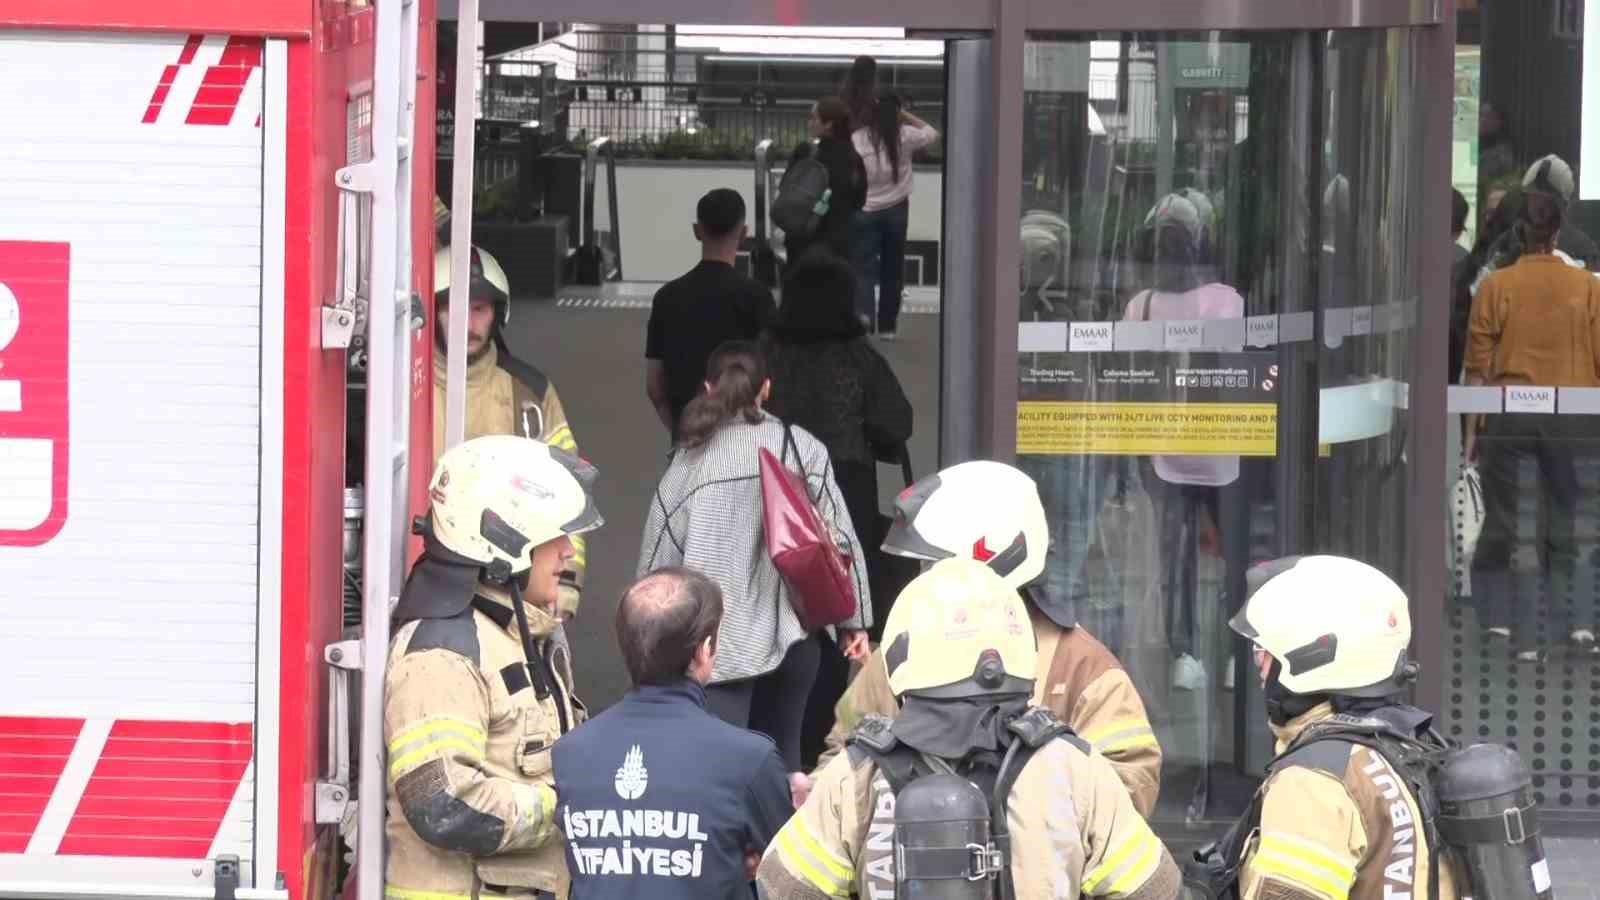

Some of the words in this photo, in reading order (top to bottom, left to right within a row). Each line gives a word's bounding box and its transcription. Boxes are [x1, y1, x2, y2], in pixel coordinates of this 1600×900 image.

[1073, 327, 1109, 338] EMAAR
[1168, 325, 1200, 337] EMAAR
[1510, 391, 1551, 401] EMAAR
[1053, 412, 1097, 421] EQUIPPED
[1099, 412, 1123, 421] WITH
[1124, 412, 1143, 421] 24/7
[1145, 413, 1166, 422] LIVE
[1167, 413, 1190, 422] CCTV
[1192, 413, 1248, 423] MONITORING
[1250, 414, 1269, 423] AND
[563, 804, 709, 842] İSTANBUL
[570, 839, 704, 877] İTFAİYESİ
